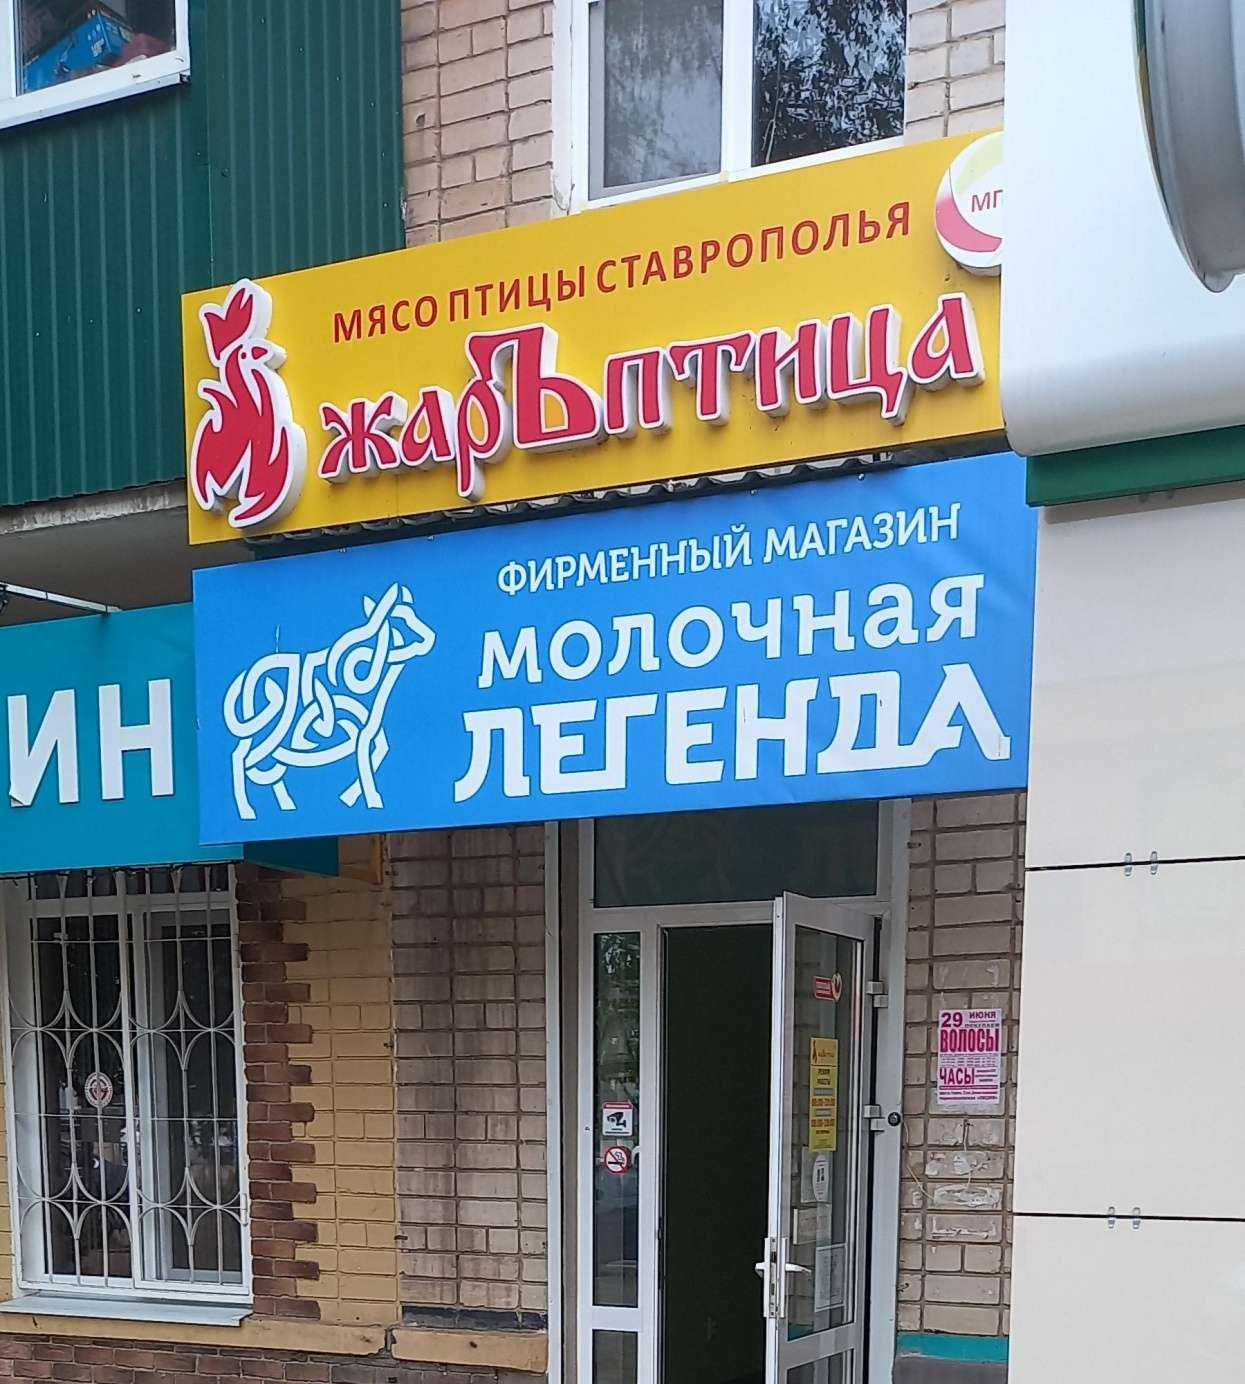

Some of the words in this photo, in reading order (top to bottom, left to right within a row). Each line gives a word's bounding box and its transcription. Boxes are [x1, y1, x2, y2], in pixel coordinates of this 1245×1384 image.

[332, 296, 438, 344] МЯСО
[448, 265, 586, 323] ПТИЦЫ
[596, 200, 911, 294] СТАВРОПОЛЬЯ
[497, 524, 753, 595] ФИРМЕННЫЙ
[763, 502, 962, 564] МАГАЗИН
[6, 678, 175, 808] ИН
[453, 662, 1012, 803] ЛЕГЕНДА
[939, 1027, 1000, 1053] ВОЛОСЫ
[940, 1011, 963, 1028] 29
[968, 1010, 997, 1020] ИЮНЯ
[939, 1067, 975, 1085] ЧАСЫ
